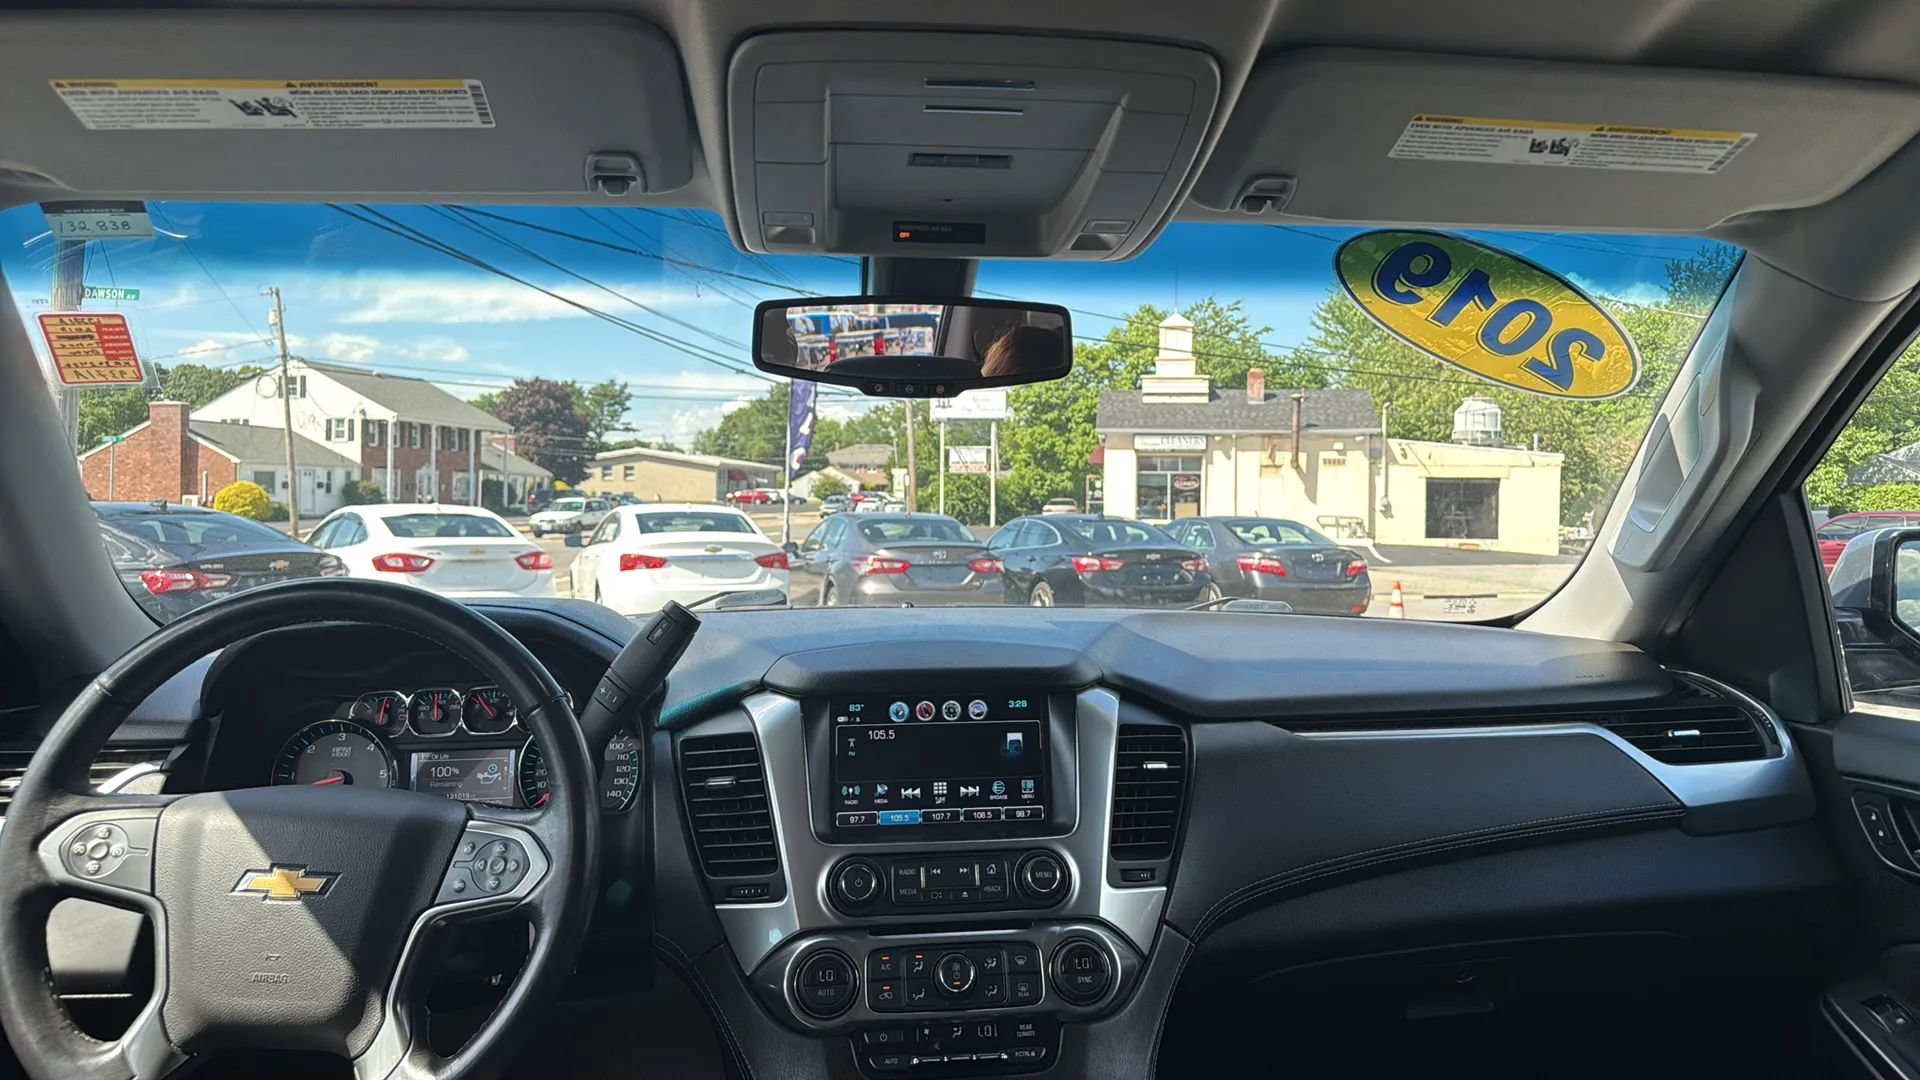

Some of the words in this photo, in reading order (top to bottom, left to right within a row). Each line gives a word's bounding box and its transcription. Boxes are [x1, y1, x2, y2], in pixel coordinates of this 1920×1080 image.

[85, 287, 125, 299] DAWSON
[1008, 700, 1028, 708] 3:28
[338, 732, 347, 741] 3
[868, 729, 896, 740] 105.5
[307, 744, 316, 754] 2
[366, 743, 376, 752] 4
[608, 742, 625, 750] 100
[379, 769, 388, 778] 5
[430, 766, 460, 778] 100%
[613, 777, 629, 785] 130
[606, 790, 622, 798] 140
[890, 814, 909, 822] 105.5
[932, 813, 951, 821] 107.7
[880, 964, 892, 972] A/C
[252, 972, 289, 984] AIRBAG
[1077, 975, 1093, 984] SYNC
[817, 988, 835, 997] AUTO
